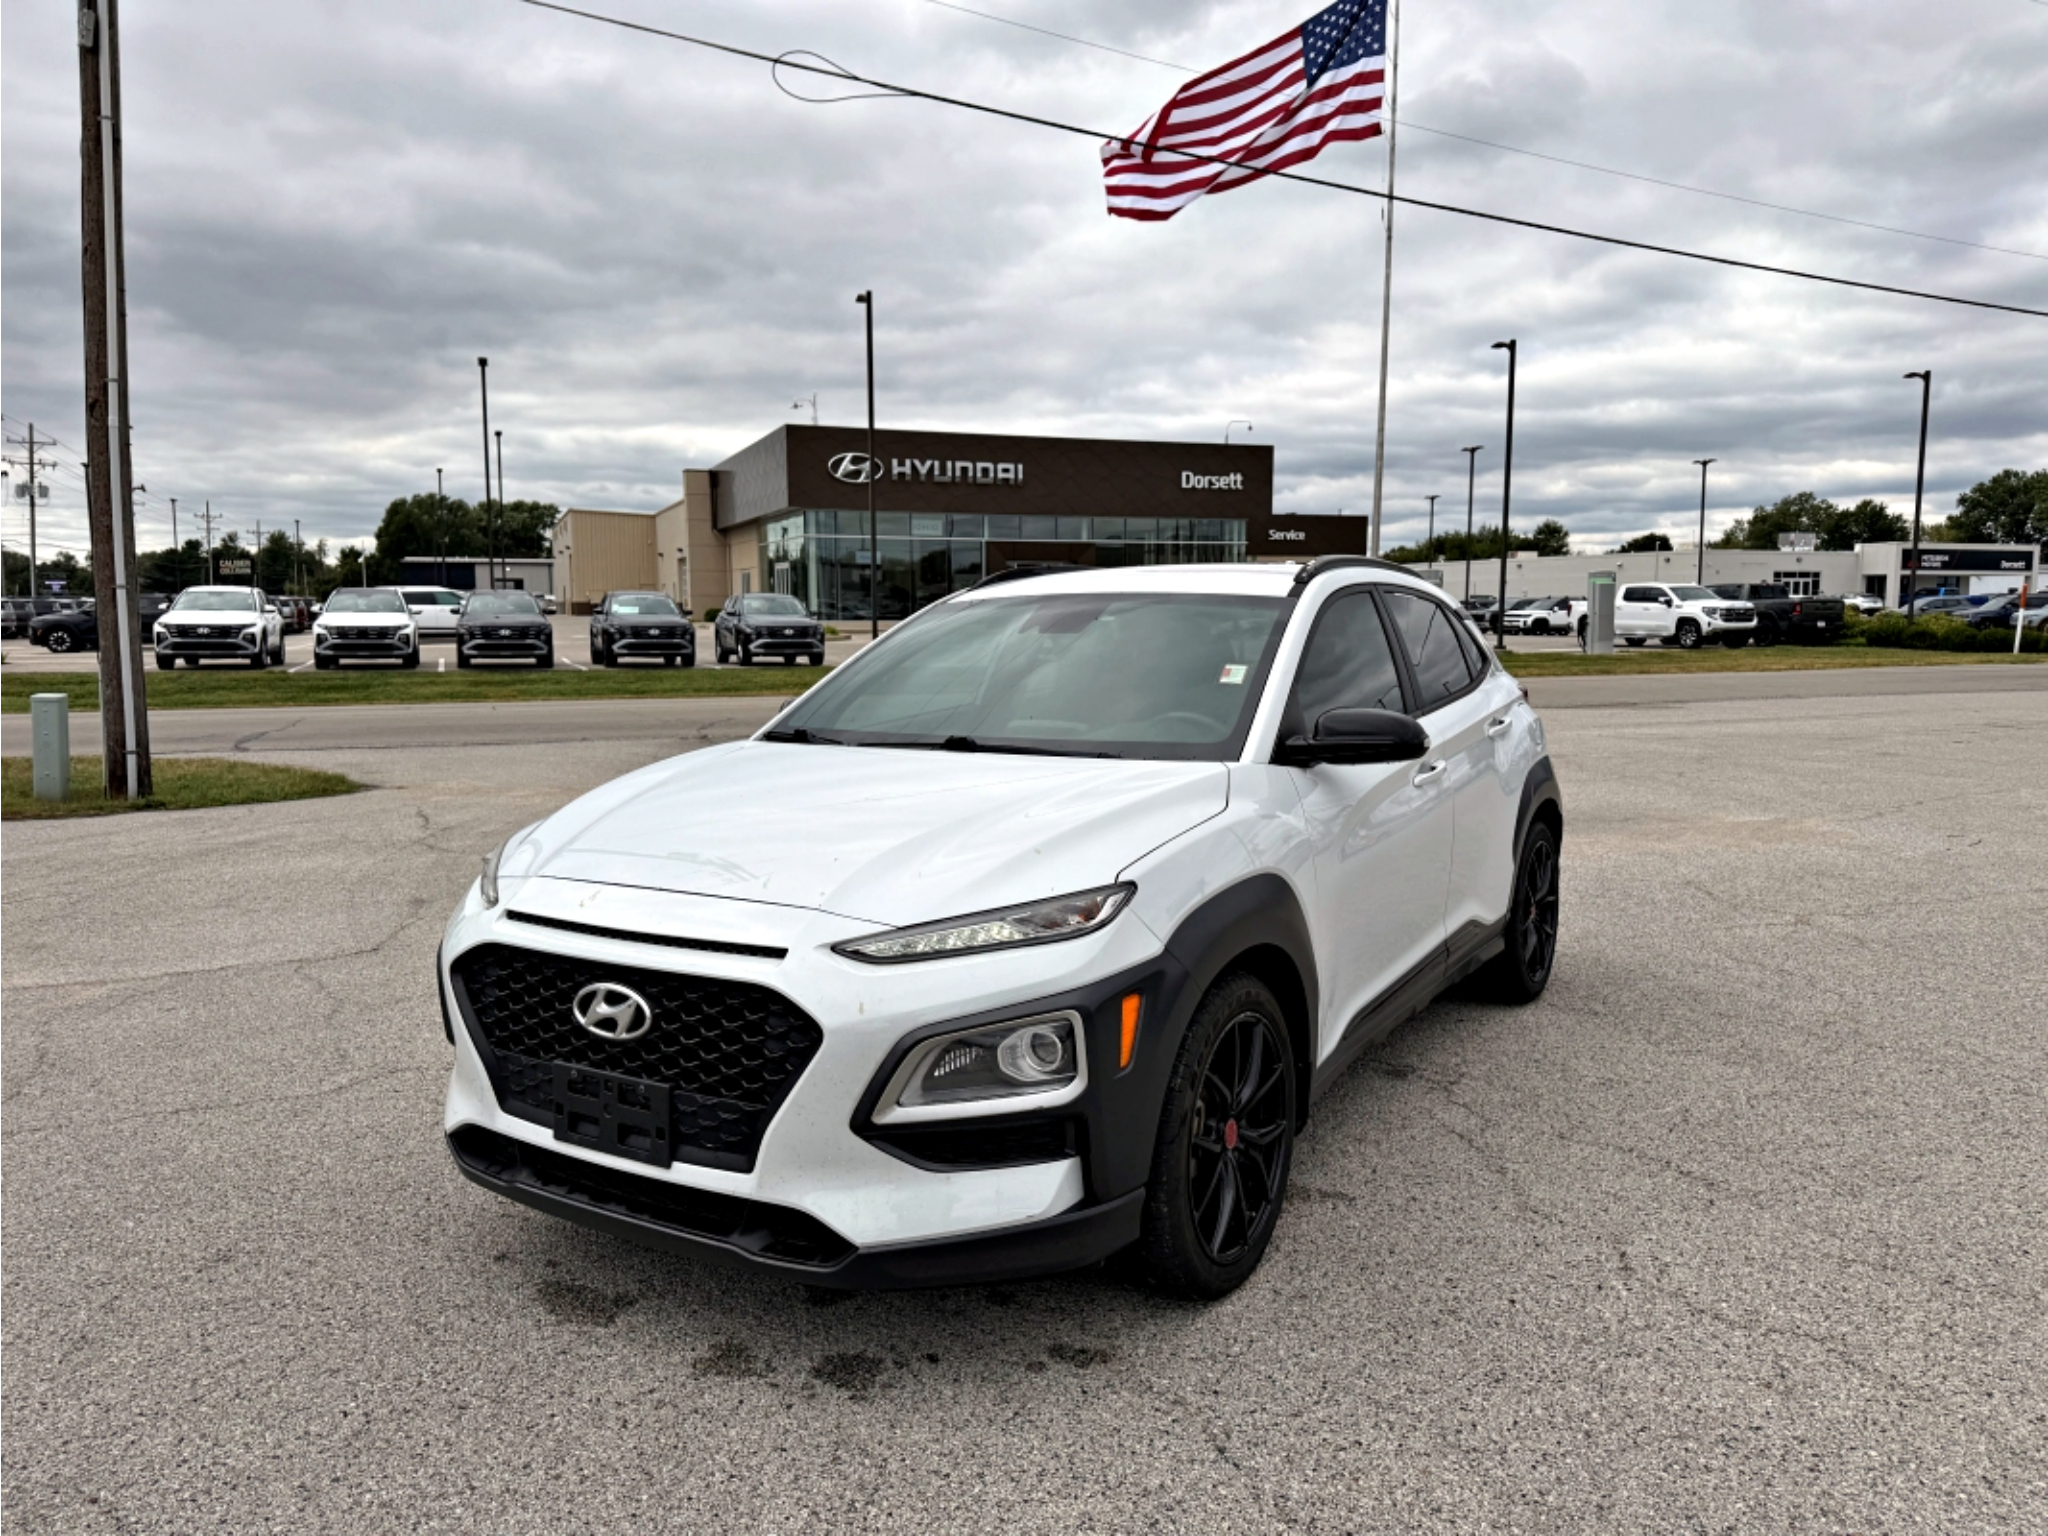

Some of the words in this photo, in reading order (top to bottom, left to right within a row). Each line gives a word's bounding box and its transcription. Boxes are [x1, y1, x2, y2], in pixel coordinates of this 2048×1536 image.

[892, 458, 1023, 485] HYUNDAI
[1181, 470, 1243, 490] Dorsett
[1268, 529, 1306, 540] Service
